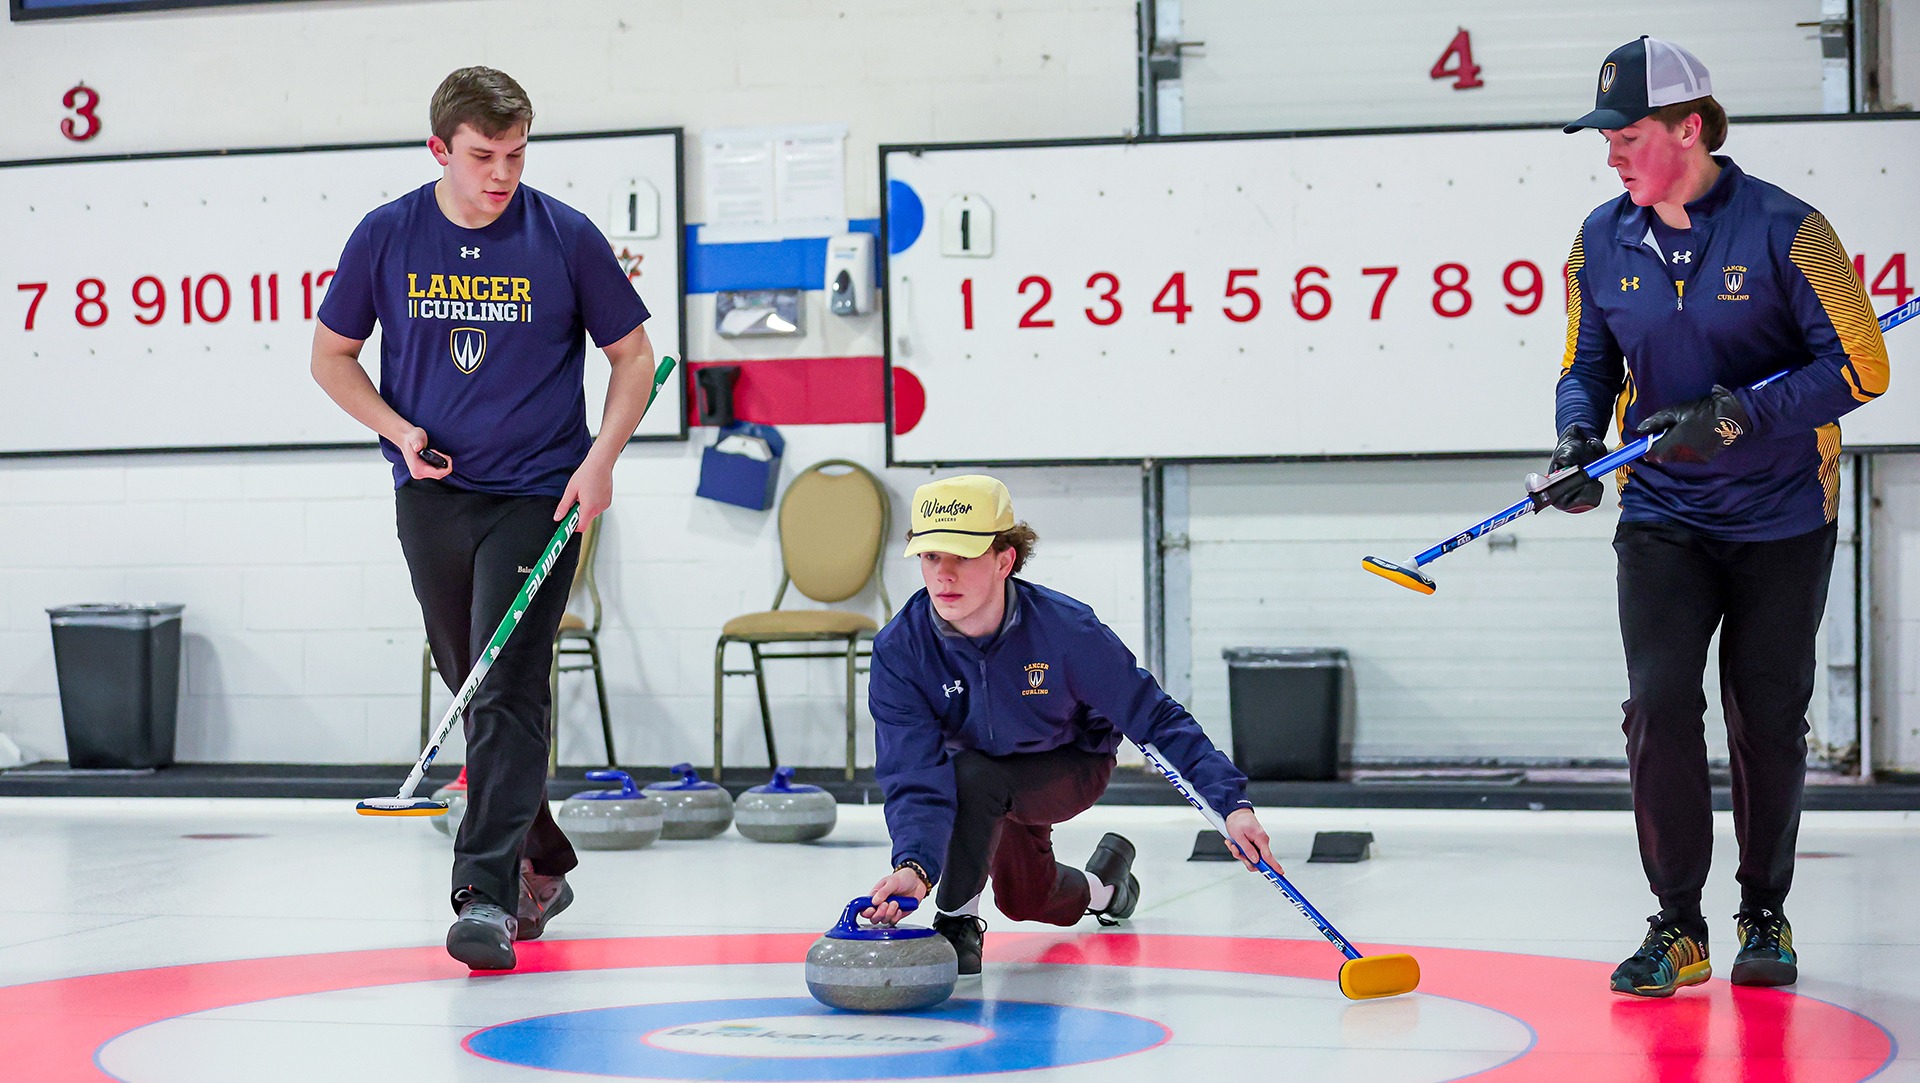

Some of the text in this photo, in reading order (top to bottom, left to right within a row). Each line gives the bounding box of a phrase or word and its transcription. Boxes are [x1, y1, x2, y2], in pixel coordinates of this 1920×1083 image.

[1431, 30, 1483, 89] 4
[61, 86, 100, 141] 3
[628, 192, 637, 232] 1
[960, 210, 970, 251] 1
[407, 273, 532, 302] LANCER
[1722, 264, 1748, 272] LANCER
[17, 282, 48, 331] 7
[75, 278, 109, 328] 8
[131, 275, 166, 326] 9
[181, 273, 231, 325] 10
[250, 273, 279, 322] 11
[420, 299, 518, 322] CURLING
[960, 278, 974, 330] 1
[1017, 275, 1054, 329] 2
[1085, 271, 1123, 327] 3
[1152, 271, 1193, 325] 4
[1223, 268, 1262, 323] 5
[1291, 265, 1332, 322] 6
[1361, 266, 1399, 321] 7
[1431, 262, 1473, 319] 8
[1502, 259, 1544, 316] 9
[920, 498, 973, 519] Windsor
[1478, 500, 1535, 537] Hardli
[525, 504, 580, 603] ardline
[1023, 662, 1050, 671] LANCER
[1135, 742, 1204, 811] ardline
